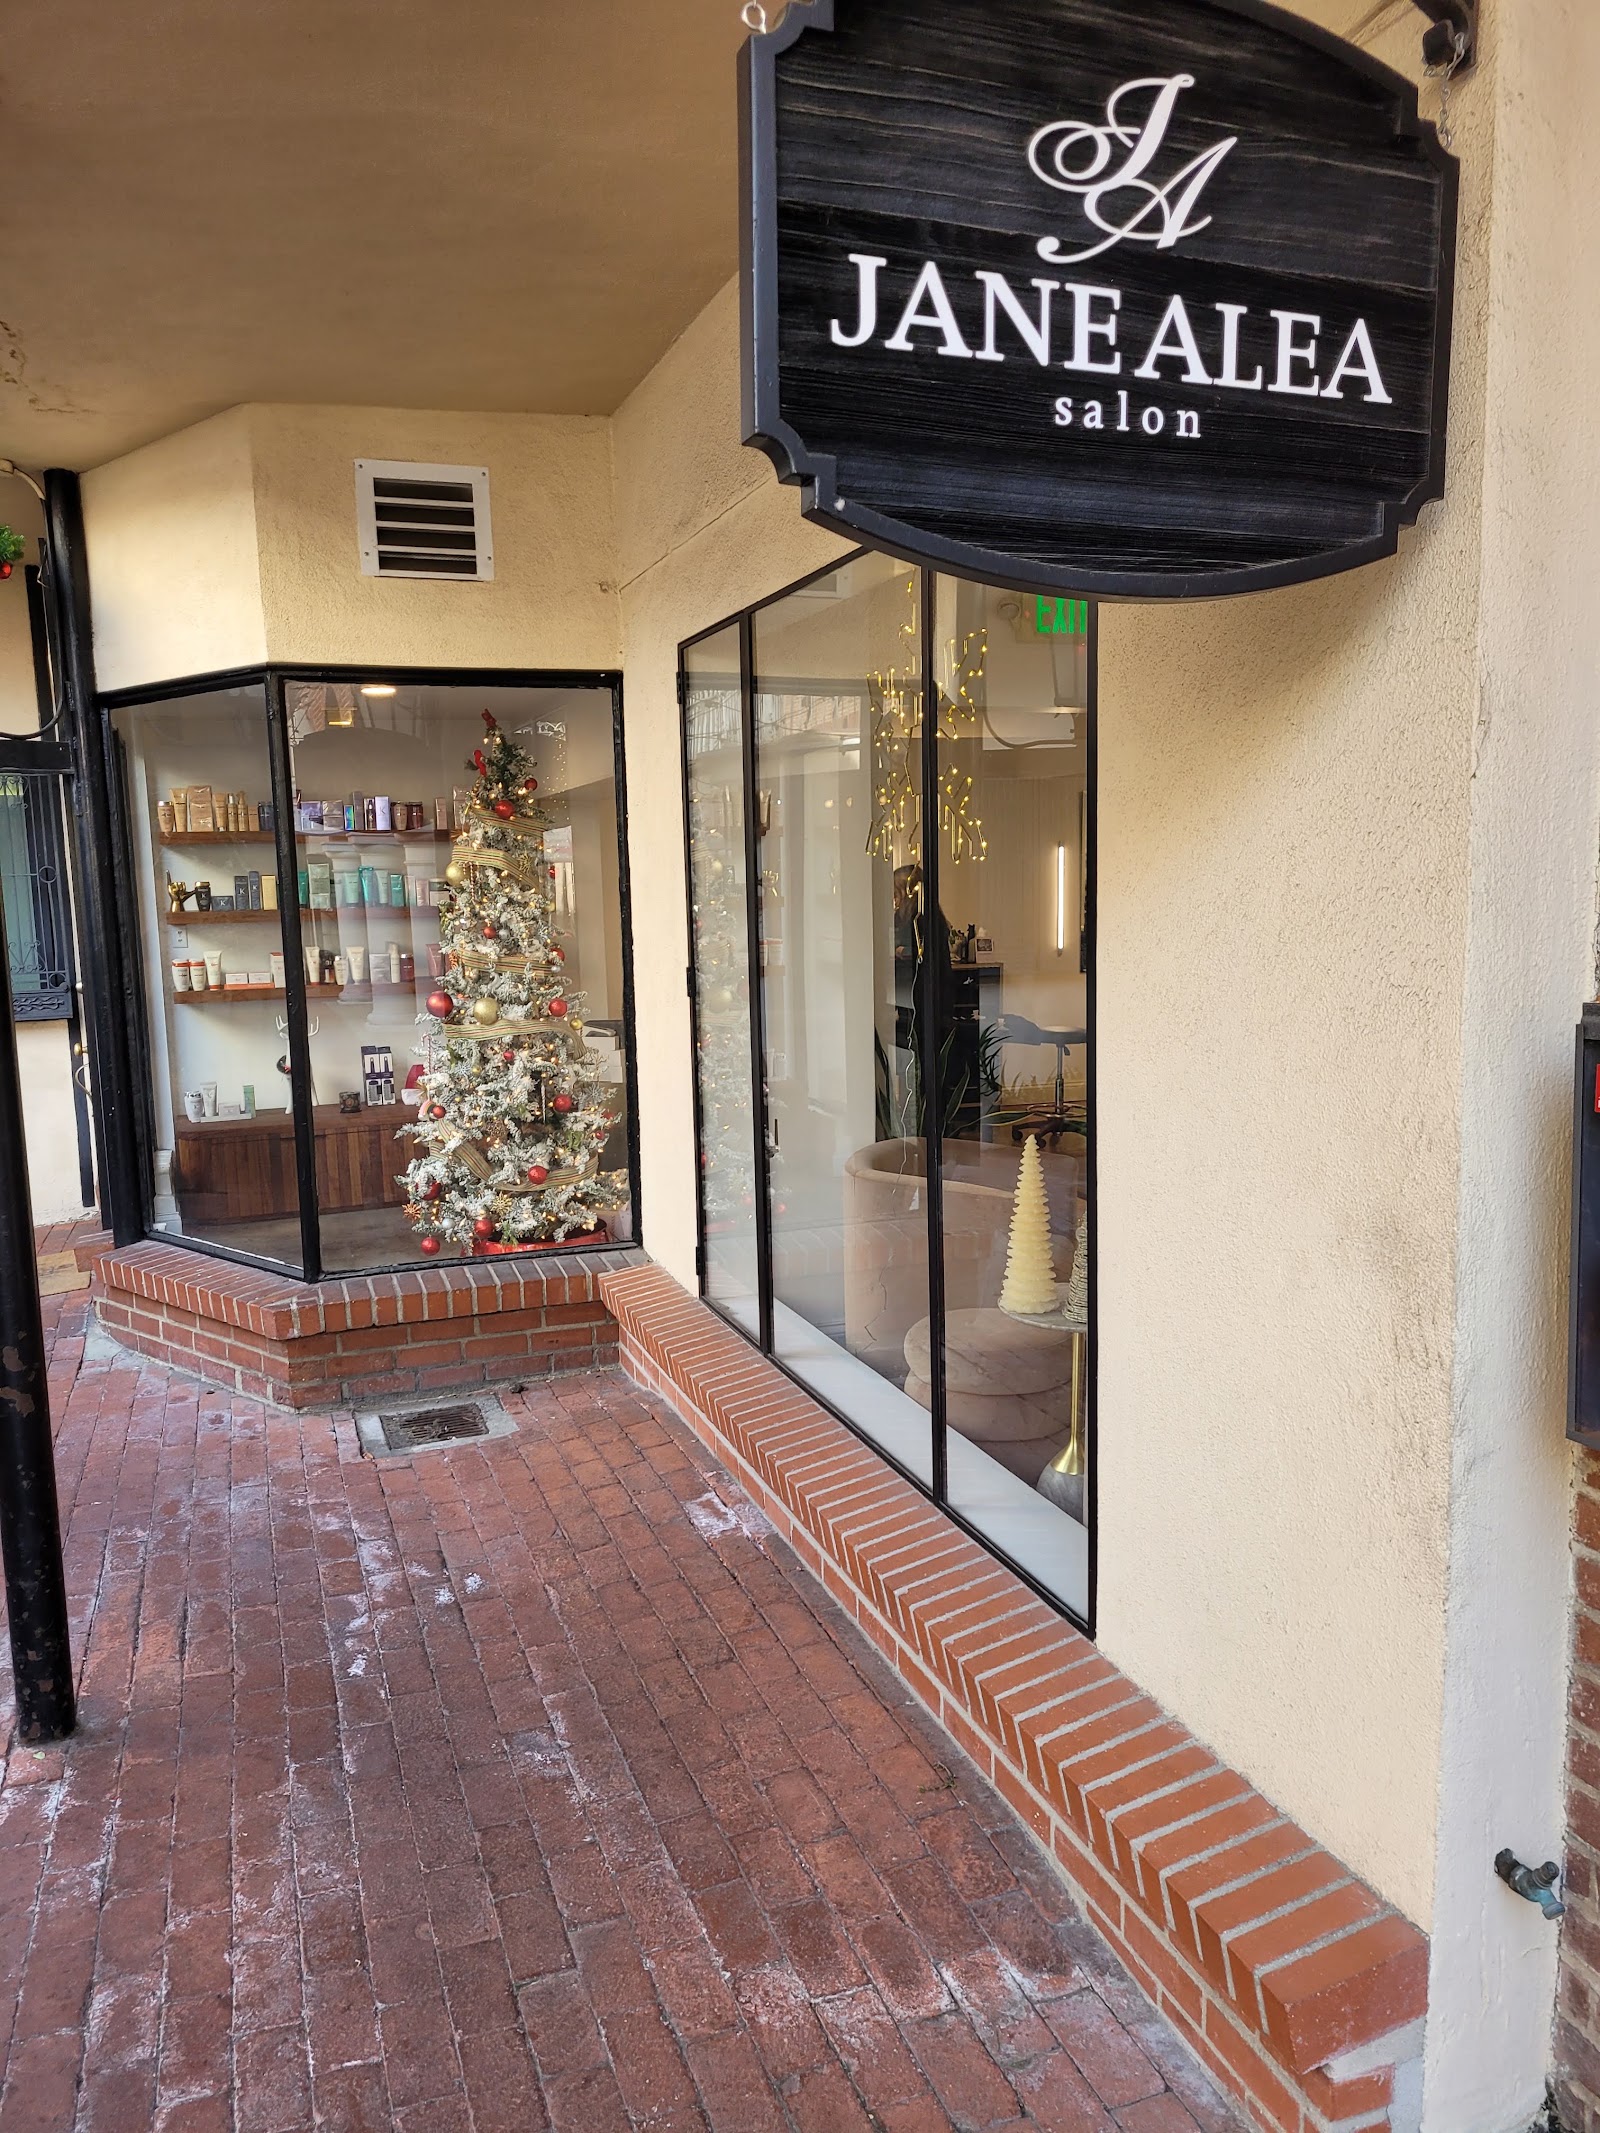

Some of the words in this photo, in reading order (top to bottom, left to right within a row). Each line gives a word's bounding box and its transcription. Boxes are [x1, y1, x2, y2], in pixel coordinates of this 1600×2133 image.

[830, 253, 1122, 375] JANE
[1134, 294, 1393, 404] ALEA
[1054, 391, 1202, 438] salon
